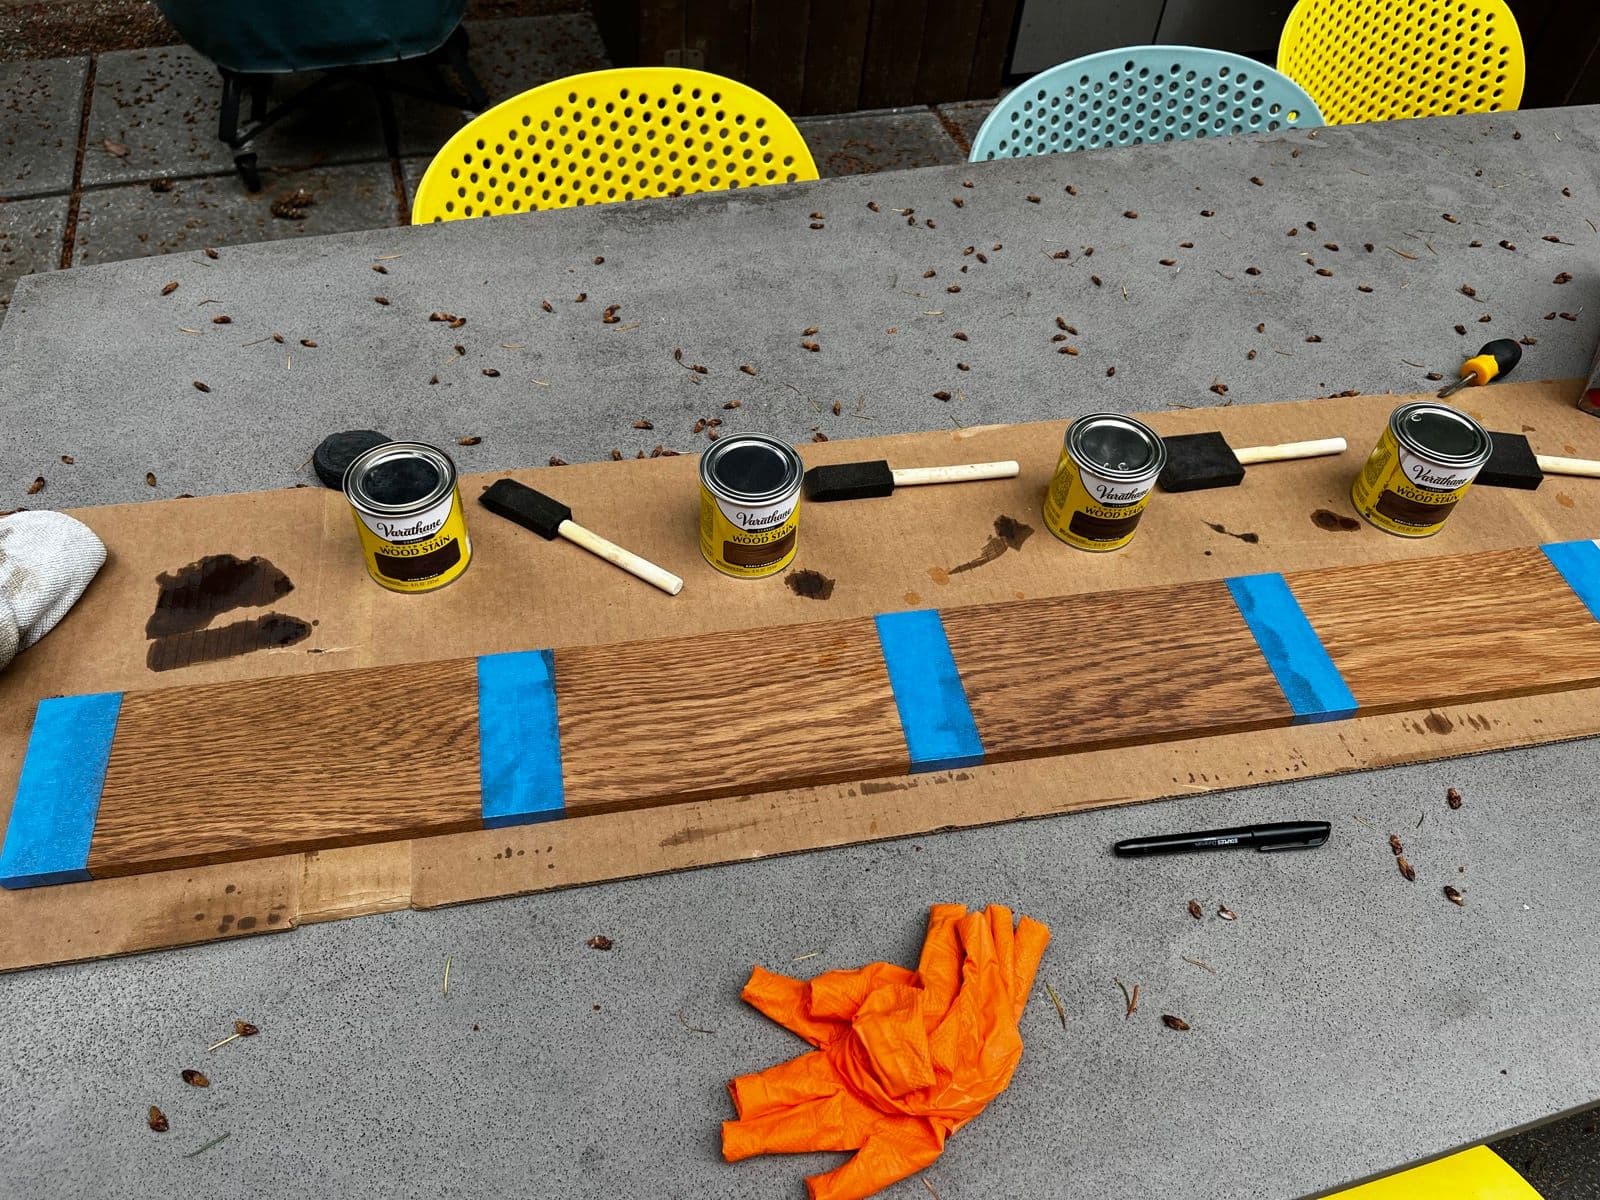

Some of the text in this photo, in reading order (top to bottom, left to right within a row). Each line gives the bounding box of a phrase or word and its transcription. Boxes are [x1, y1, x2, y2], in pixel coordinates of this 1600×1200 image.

[1397, 486, 1432, 503] WOOD
[1086, 506, 1121, 519] WOOD
[376, 519, 442, 537] Varathane
[733, 535, 769, 545] WOOD
[771, 524, 793, 540] STAIN
[380, 546, 420, 557] WOOD
[422, 535, 451, 553] STAIN
